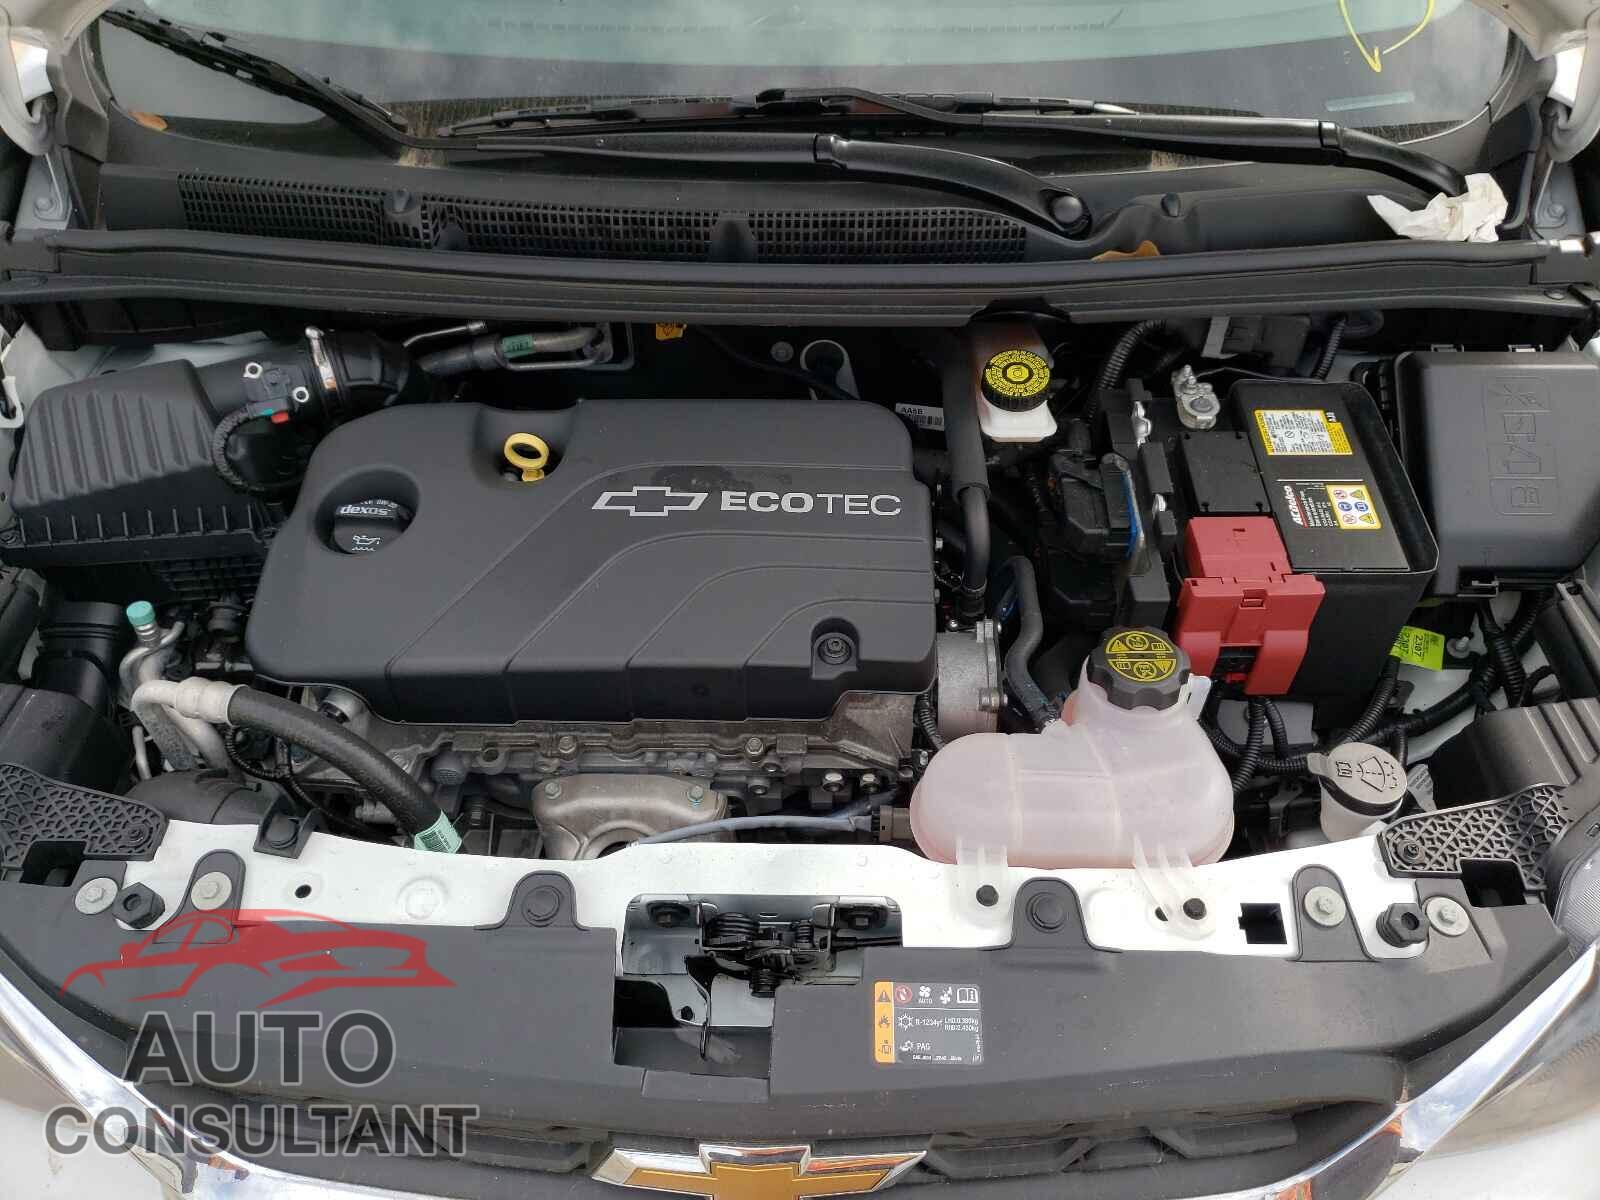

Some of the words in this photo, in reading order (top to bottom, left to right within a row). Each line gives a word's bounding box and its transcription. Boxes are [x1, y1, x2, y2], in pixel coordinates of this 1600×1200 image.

[720, 491, 902, 516] ECOTEC
[340, 504, 388, 516] dexos
[916, 1042, 932, 1051] PAG
